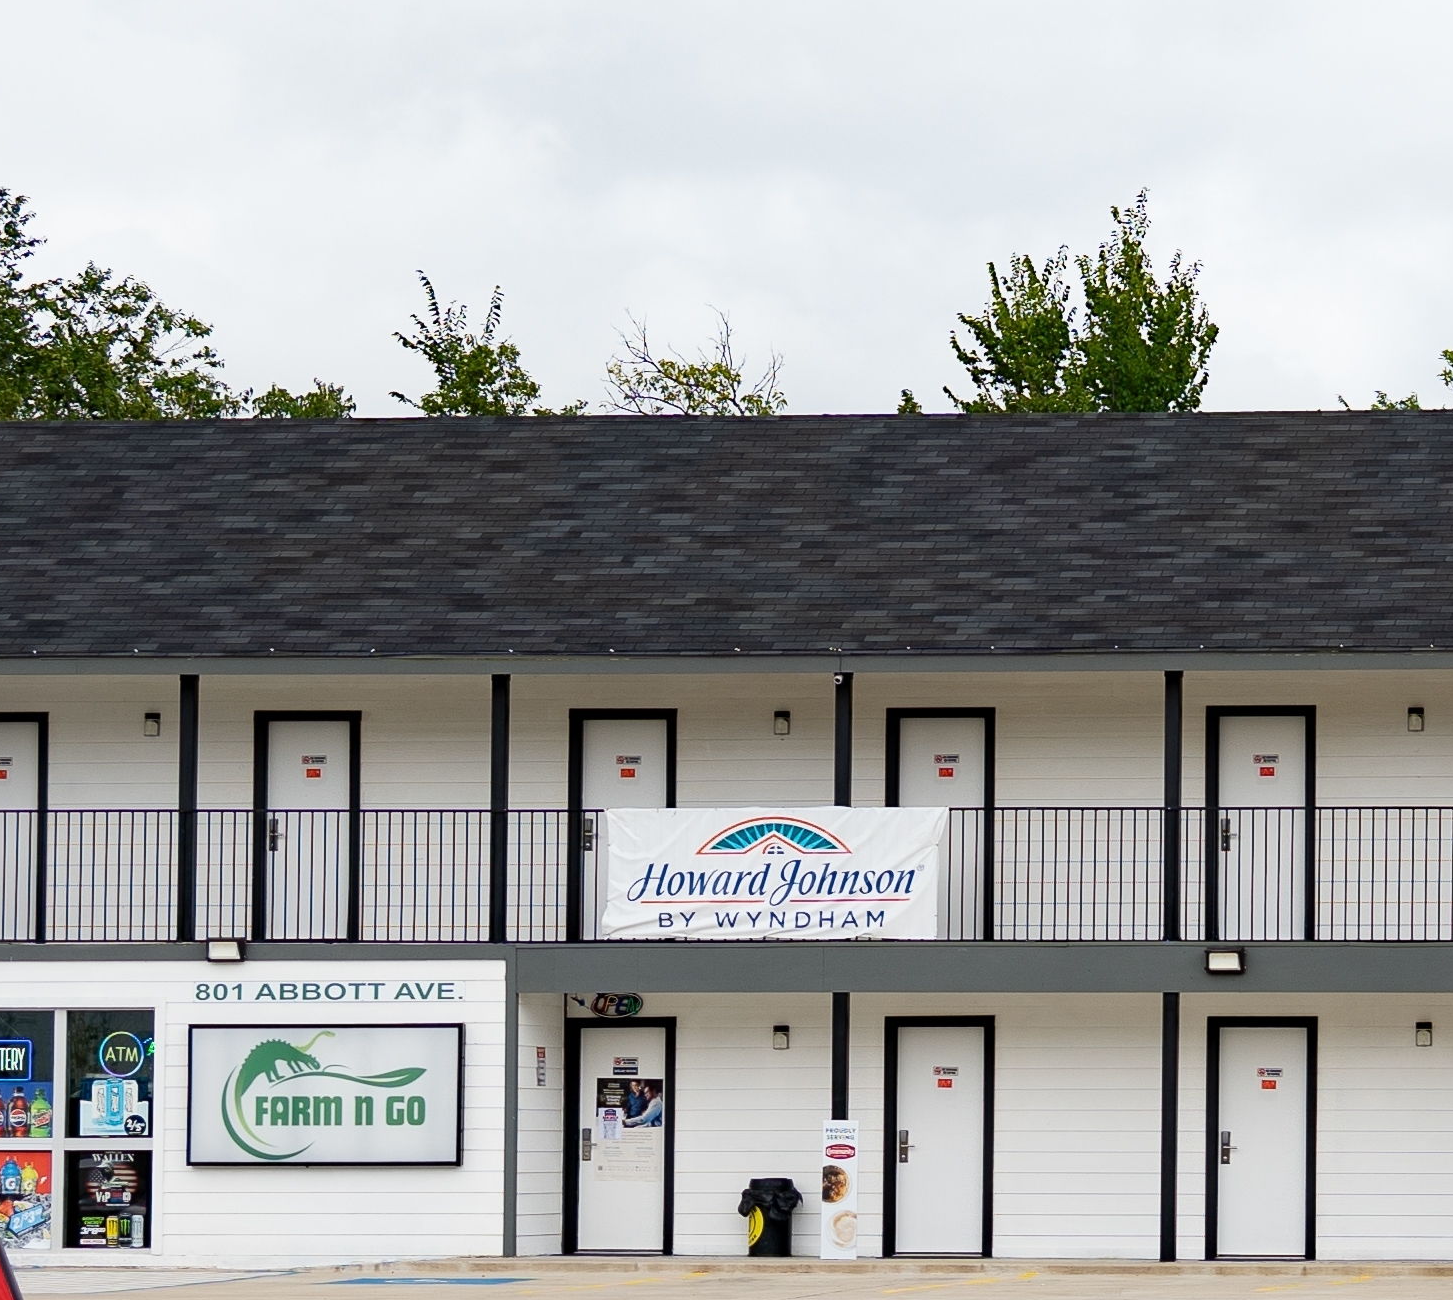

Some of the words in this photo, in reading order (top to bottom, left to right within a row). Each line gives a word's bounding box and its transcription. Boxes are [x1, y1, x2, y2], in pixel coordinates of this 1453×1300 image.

[627, 863, 771, 901] Howard
[769, 860, 916, 906] Johnson
[659, 912, 696, 928] BY
[715, 911, 885, 928] WYNDHAM
[196, 983, 244, 1001] 801
[255, 983, 386, 1001] ABBOTT
[394, 983, 463, 1001] AVE.
[596, 994, 641, 1015] OPEN
[105, 1046, 138, 1062] ATM
[386, 1096, 426, 1126] GO
[6, 1178, 16, 1189] G
[24, 1181, 32, 1190] G
